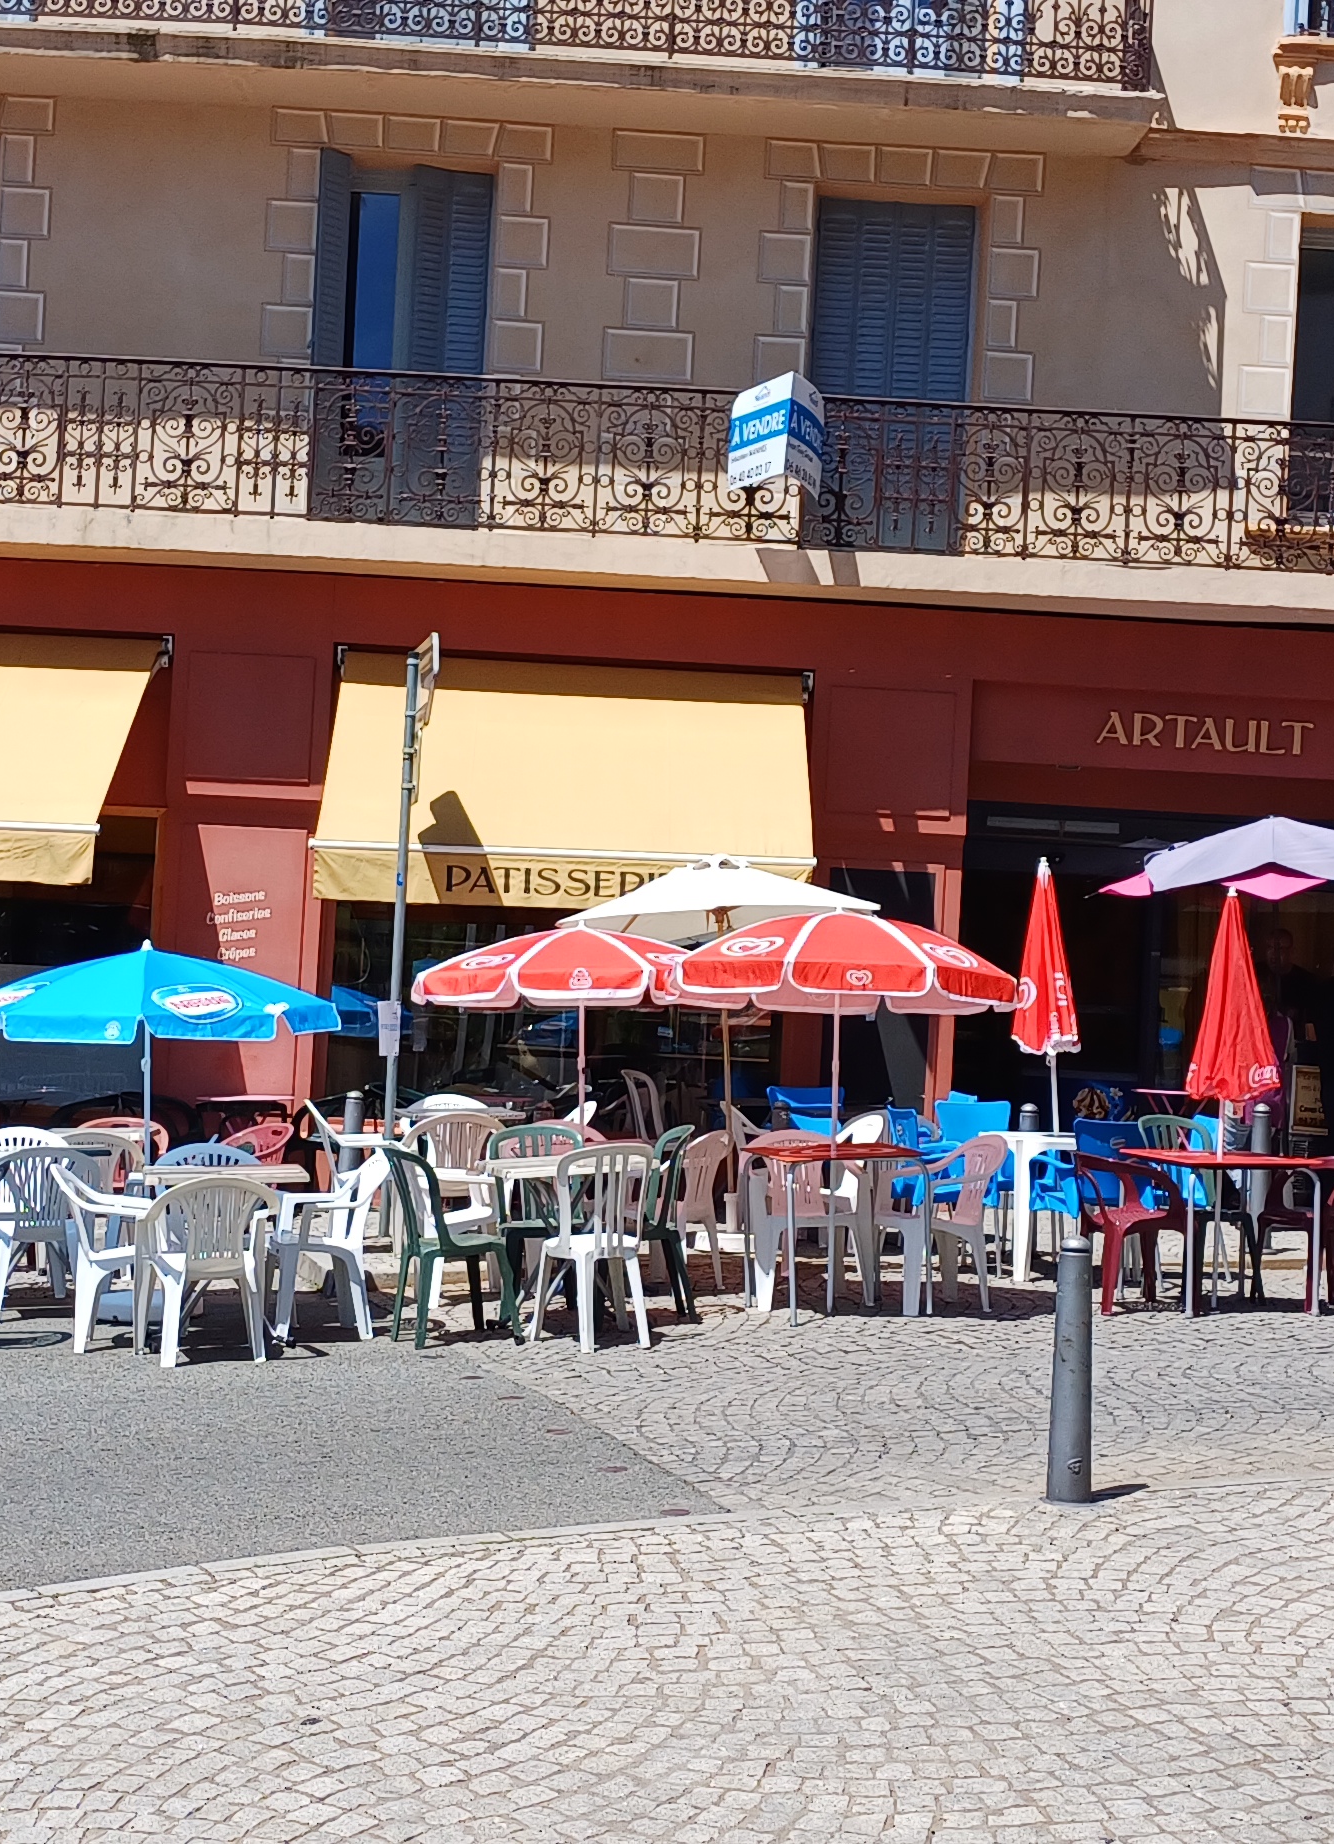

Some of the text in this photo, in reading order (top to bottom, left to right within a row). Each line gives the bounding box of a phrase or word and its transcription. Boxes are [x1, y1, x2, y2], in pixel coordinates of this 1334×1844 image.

[743, 409, 786, 442] VENDRE
[1096, 711, 1315, 755] ARTAULT
[445, 864, 668, 898] PATISSER
[214, 890, 266, 906] Boissons
[206, 907, 271, 925] Confiseries
[219, 928, 257, 942] Glaces
